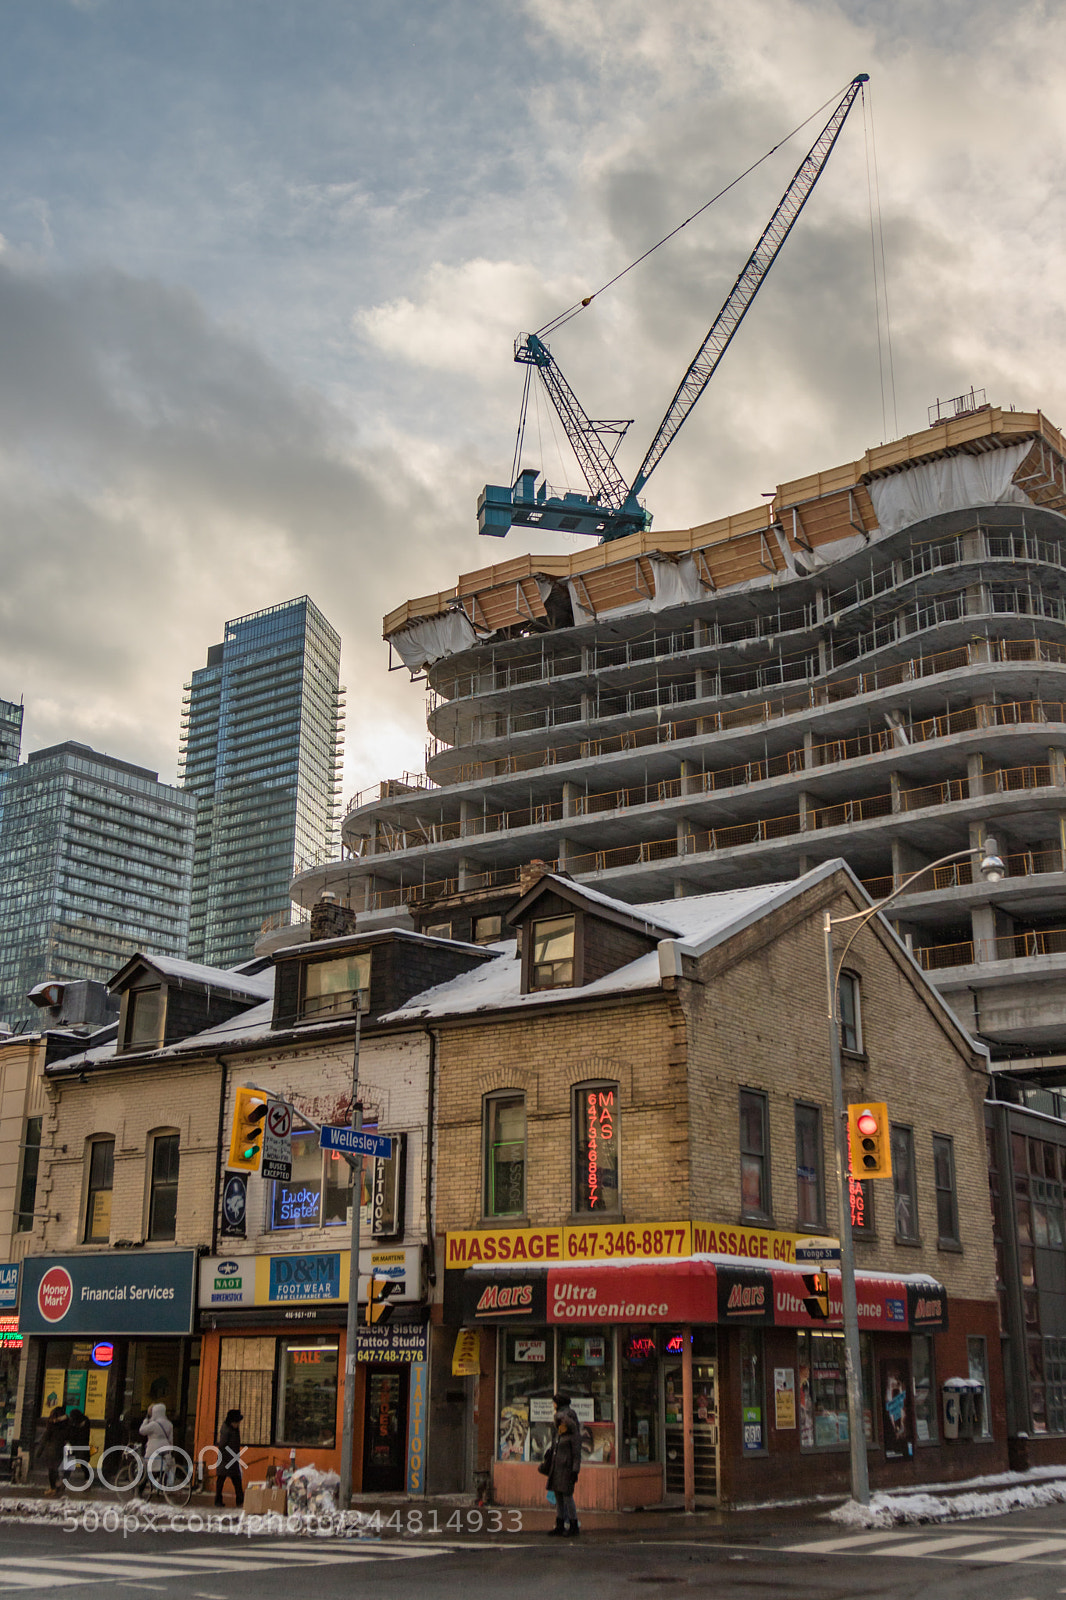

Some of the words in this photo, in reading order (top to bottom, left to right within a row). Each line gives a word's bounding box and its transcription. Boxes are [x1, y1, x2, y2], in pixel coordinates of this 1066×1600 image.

[599, 1091, 614, 1140] MAS
[330, 1128, 378, 1154] Wellesley
[263, 1168, 290, 1180] EXCEPTED
[268, 1162, 287, 1171] BUSES
[281, 1188, 320, 1206] Lucky
[374, 1158, 385, 1233] ATTOOS
[280, 1203, 319, 1220] Sister
[449, 1234, 560, 1261] MASSAGE
[567, 1229, 686, 1258] 647-346-8877
[694, 1229, 769, 1259] MASSAGE
[802, 1250, 825, 1259] Yonge
[825, 1249, 833, 1258] St
[275, 1258, 335, 1284] D&M
[42, 1284, 69, 1296] Money
[215, 1280, 242, 1289] NAOT
[278, 1285, 301, 1294] FOOT
[304, 1283, 331, 1292] WEAR
[554, 1284, 597, 1300] Ultra
[81, 1286, 127, 1301] Financial
[129, 1285, 174, 1300] Services
[477, 1285, 533, 1310] Mars
[728, 1284, 765, 1308] Mars
[44, 1296, 64, 1307] Mart
[553, 1301, 669, 1317] Convenience
[914, 1298, 942, 1318] Mars
[393, 1324, 424, 1335] Sister
[356, 1337, 389, 1347] Tattoo
[392, 1336, 425, 1347] Studio
[293, 1351, 321, 1363] SALE
[357, 1350, 424, 1362] 647-748-7376
[411, 1366, 424, 1489] TATTOOS
